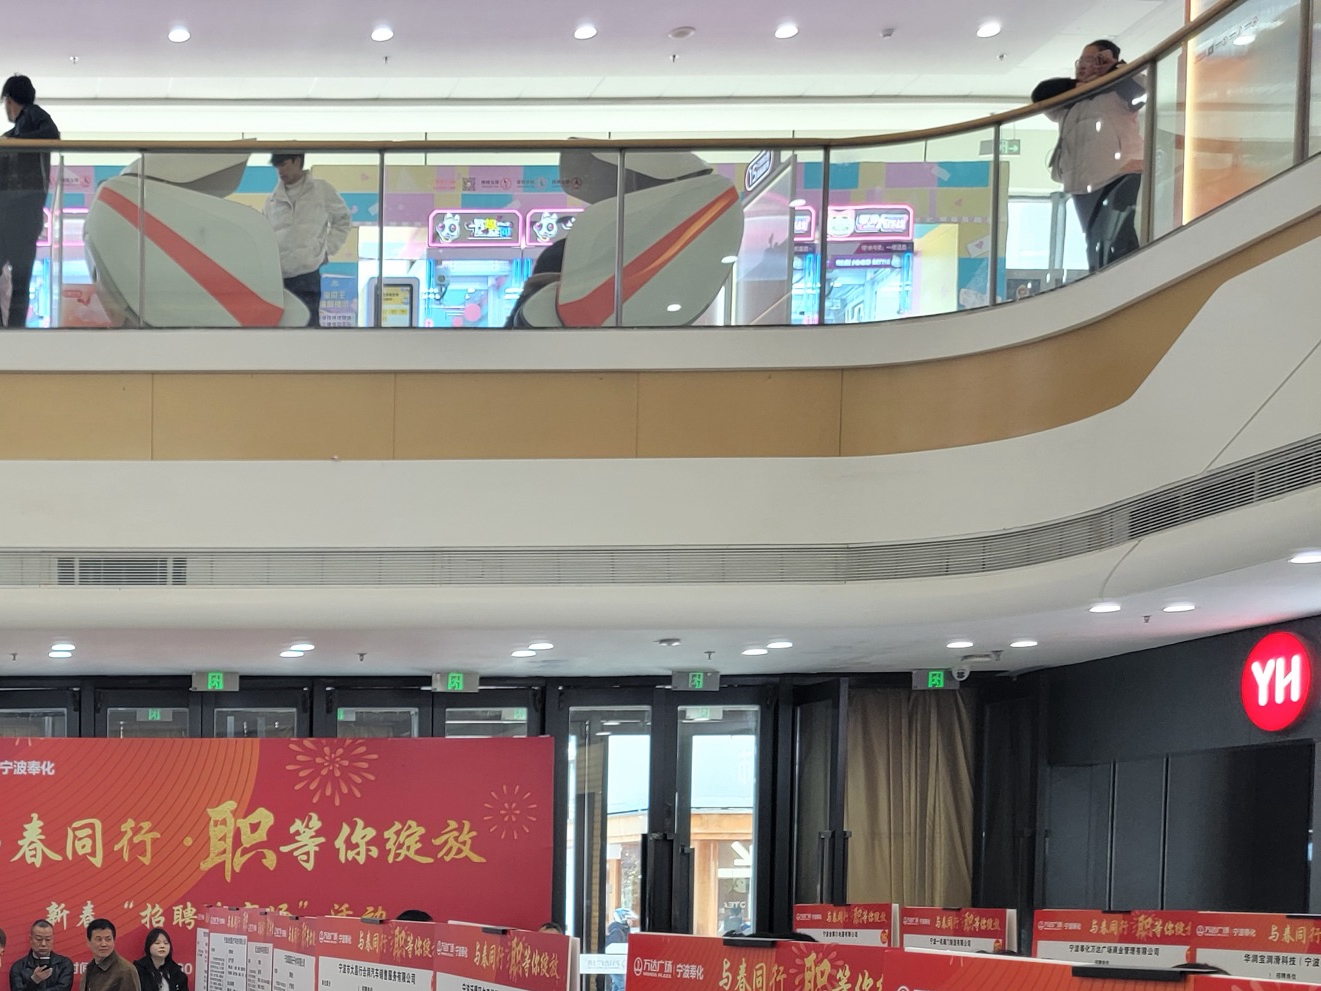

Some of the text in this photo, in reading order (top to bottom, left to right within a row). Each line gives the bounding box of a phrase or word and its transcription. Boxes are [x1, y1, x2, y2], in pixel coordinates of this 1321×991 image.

[1251, 654, 1301, 707] YH
[0, 760, 55, 775] 宁波奉化
[643, 959, 673, 974] 万达广场
[676, 962, 704, 980] 宁波奉化
